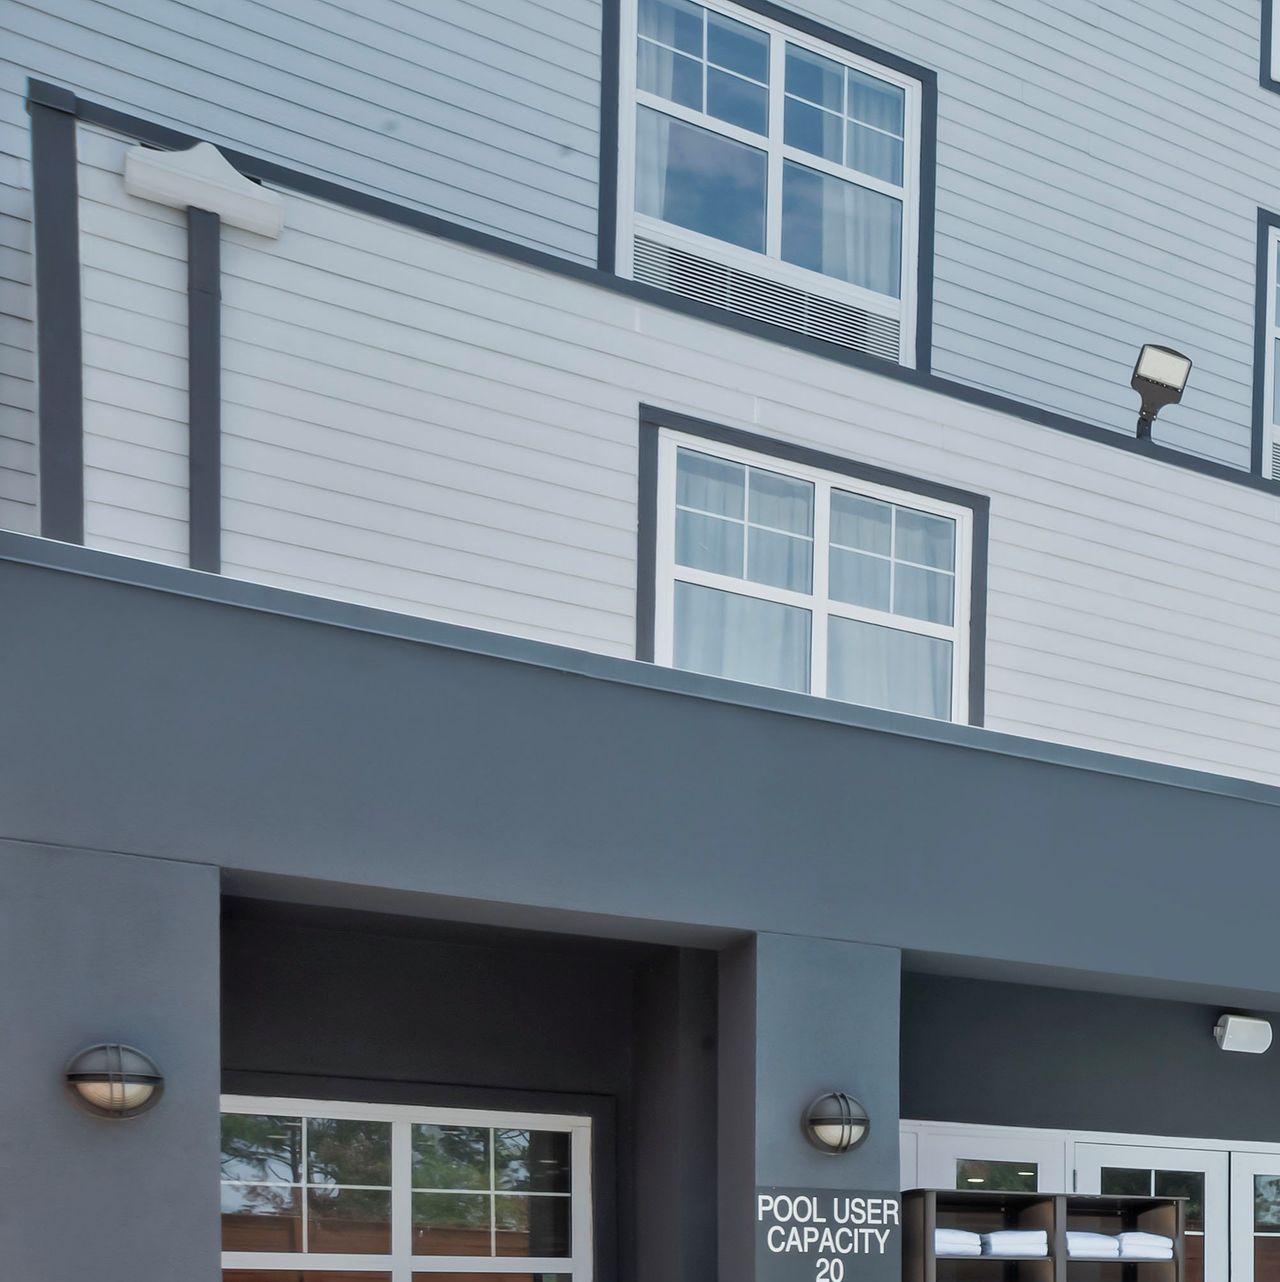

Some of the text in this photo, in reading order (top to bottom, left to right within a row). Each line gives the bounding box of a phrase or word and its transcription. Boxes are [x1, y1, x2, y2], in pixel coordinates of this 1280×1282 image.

[758, 1195, 899, 1225] POOL USER
[767, 1225, 891, 1254] CAPACITY
